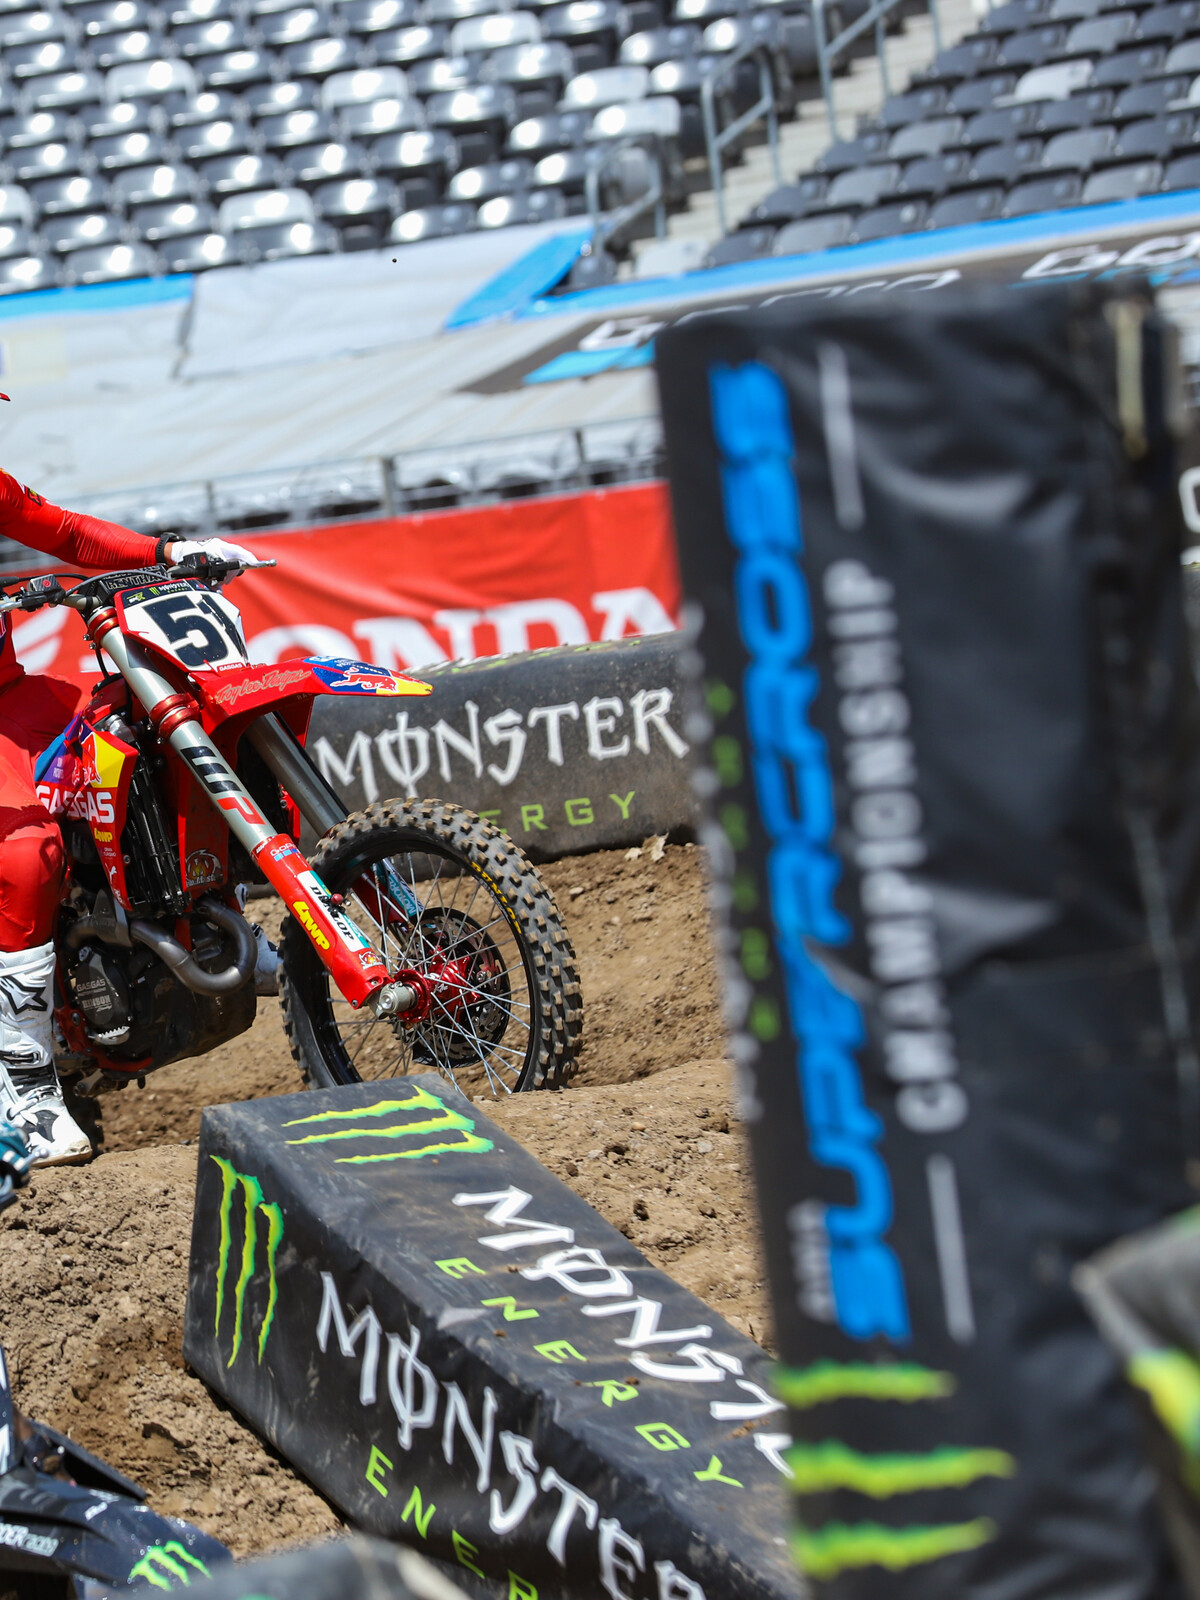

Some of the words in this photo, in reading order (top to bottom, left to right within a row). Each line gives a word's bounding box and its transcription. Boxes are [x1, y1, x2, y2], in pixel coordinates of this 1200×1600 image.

[141, 594, 249, 668] 51
[214, 684, 239, 705] Troy
[240, 679, 262, 697] Lee
[313, 686, 690, 804] MONSTER
[434, 1256, 743, 1489] ENERGY
[453, 1185, 795, 1480] MONST
[365, 1444, 538, 1600] ENER
